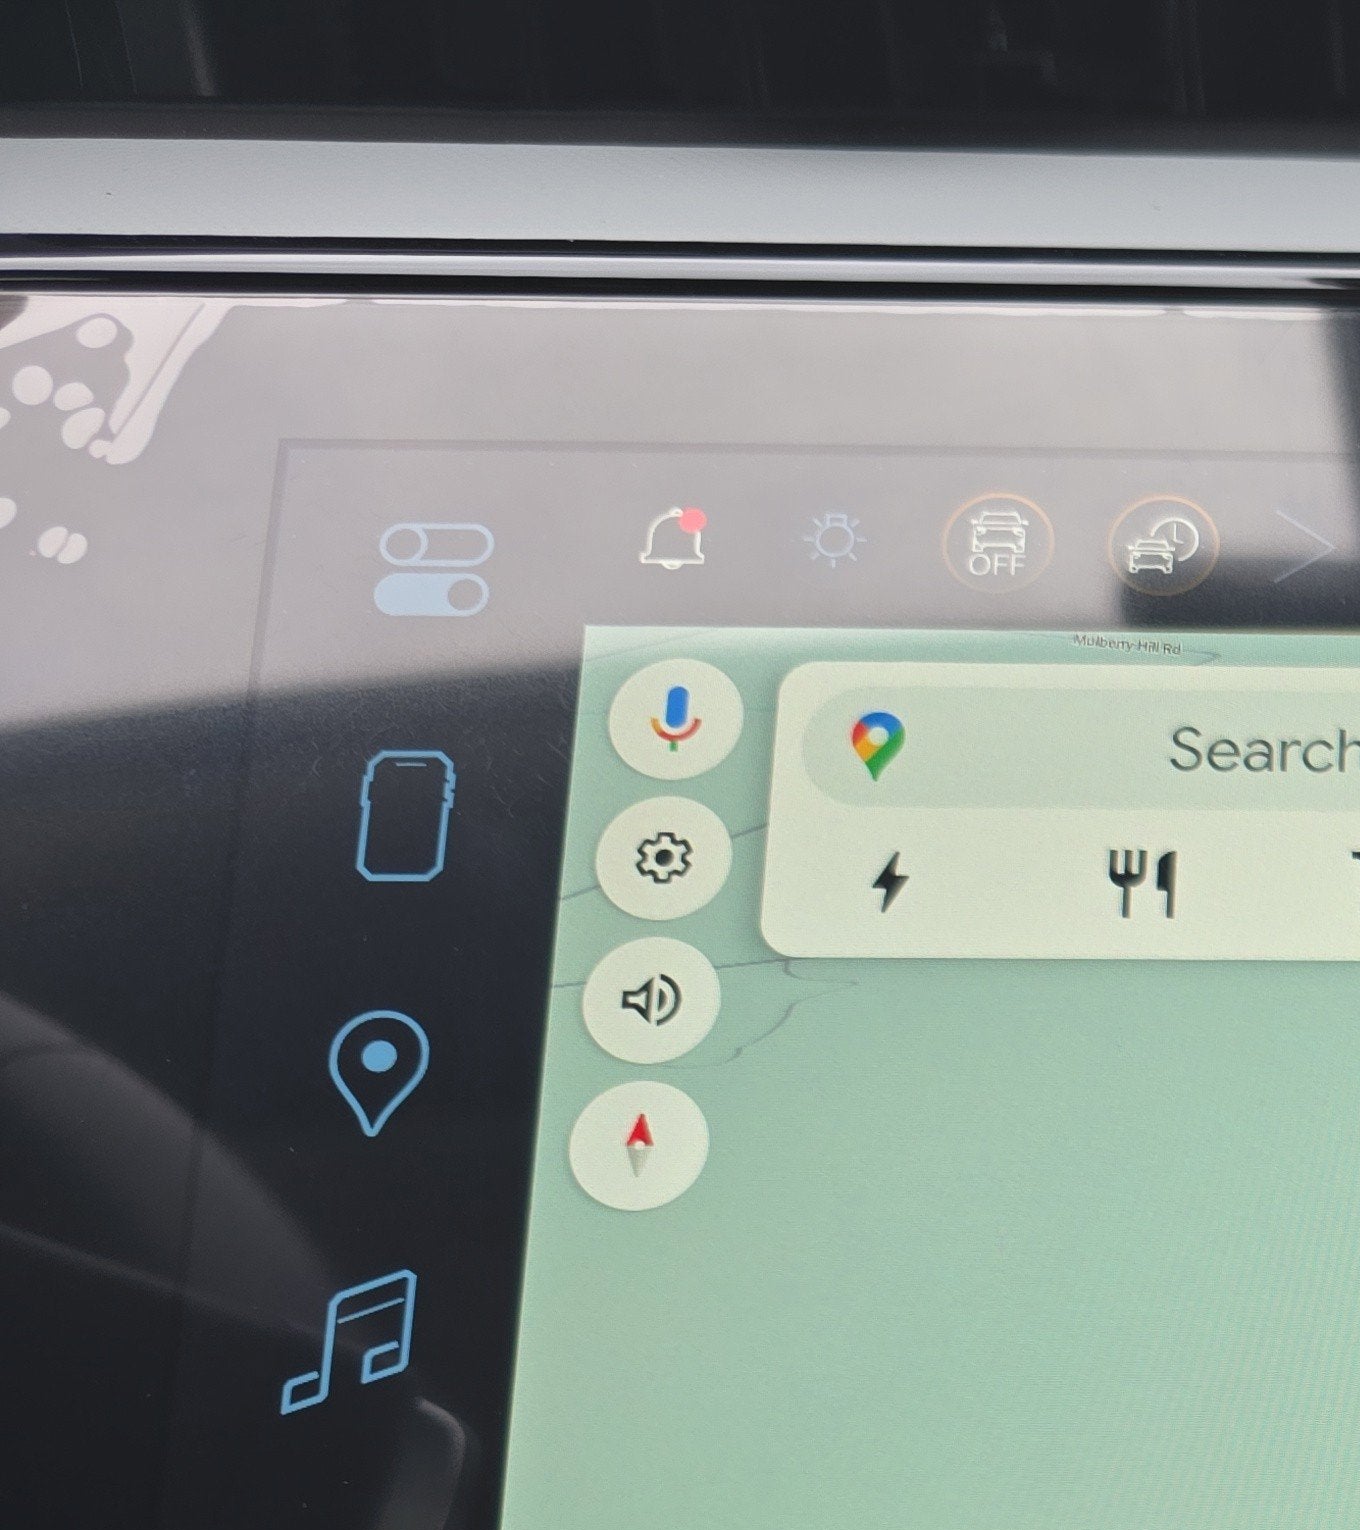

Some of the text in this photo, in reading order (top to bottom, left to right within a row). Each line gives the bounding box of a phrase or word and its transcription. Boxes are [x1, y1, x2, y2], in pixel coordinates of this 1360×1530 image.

[968, 554, 1025, 576] OFF
[1073, 634, 1133, 652] Mulberry
[1163, 643, 1182, 655] Rd
